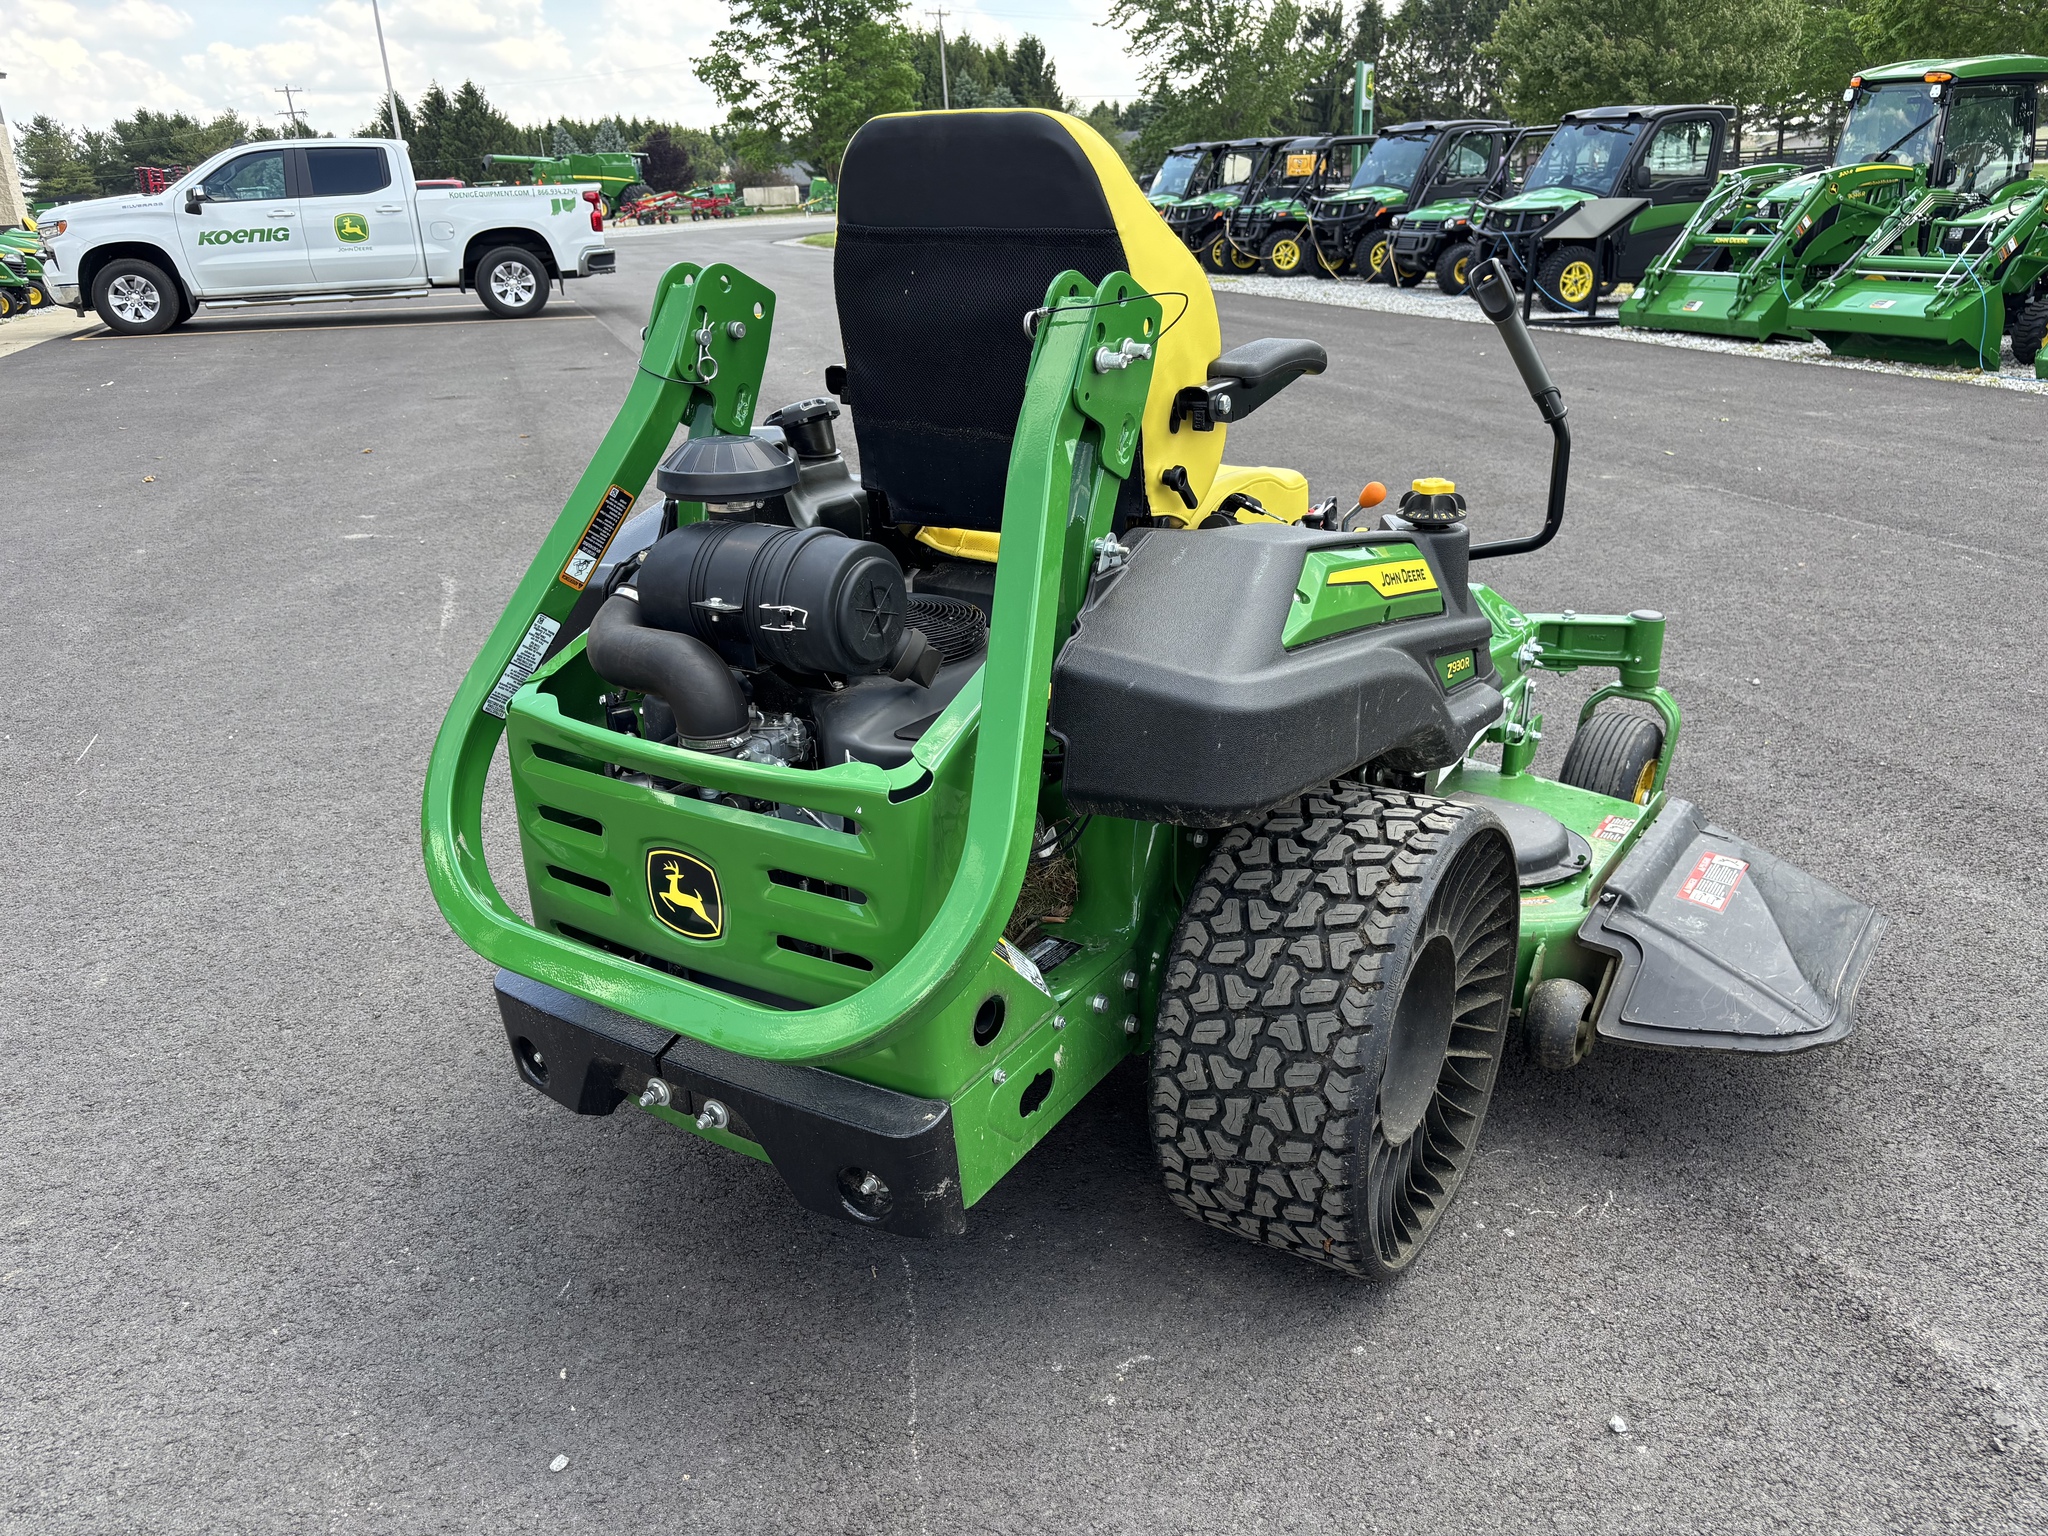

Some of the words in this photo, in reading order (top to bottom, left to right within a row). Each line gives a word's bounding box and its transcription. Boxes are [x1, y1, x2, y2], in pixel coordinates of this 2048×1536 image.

[1381, 571, 1402, 587] JOHN
[1401, 568, 1427, 583] DEERE
[1447, 656, 1470, 679] Z930R
